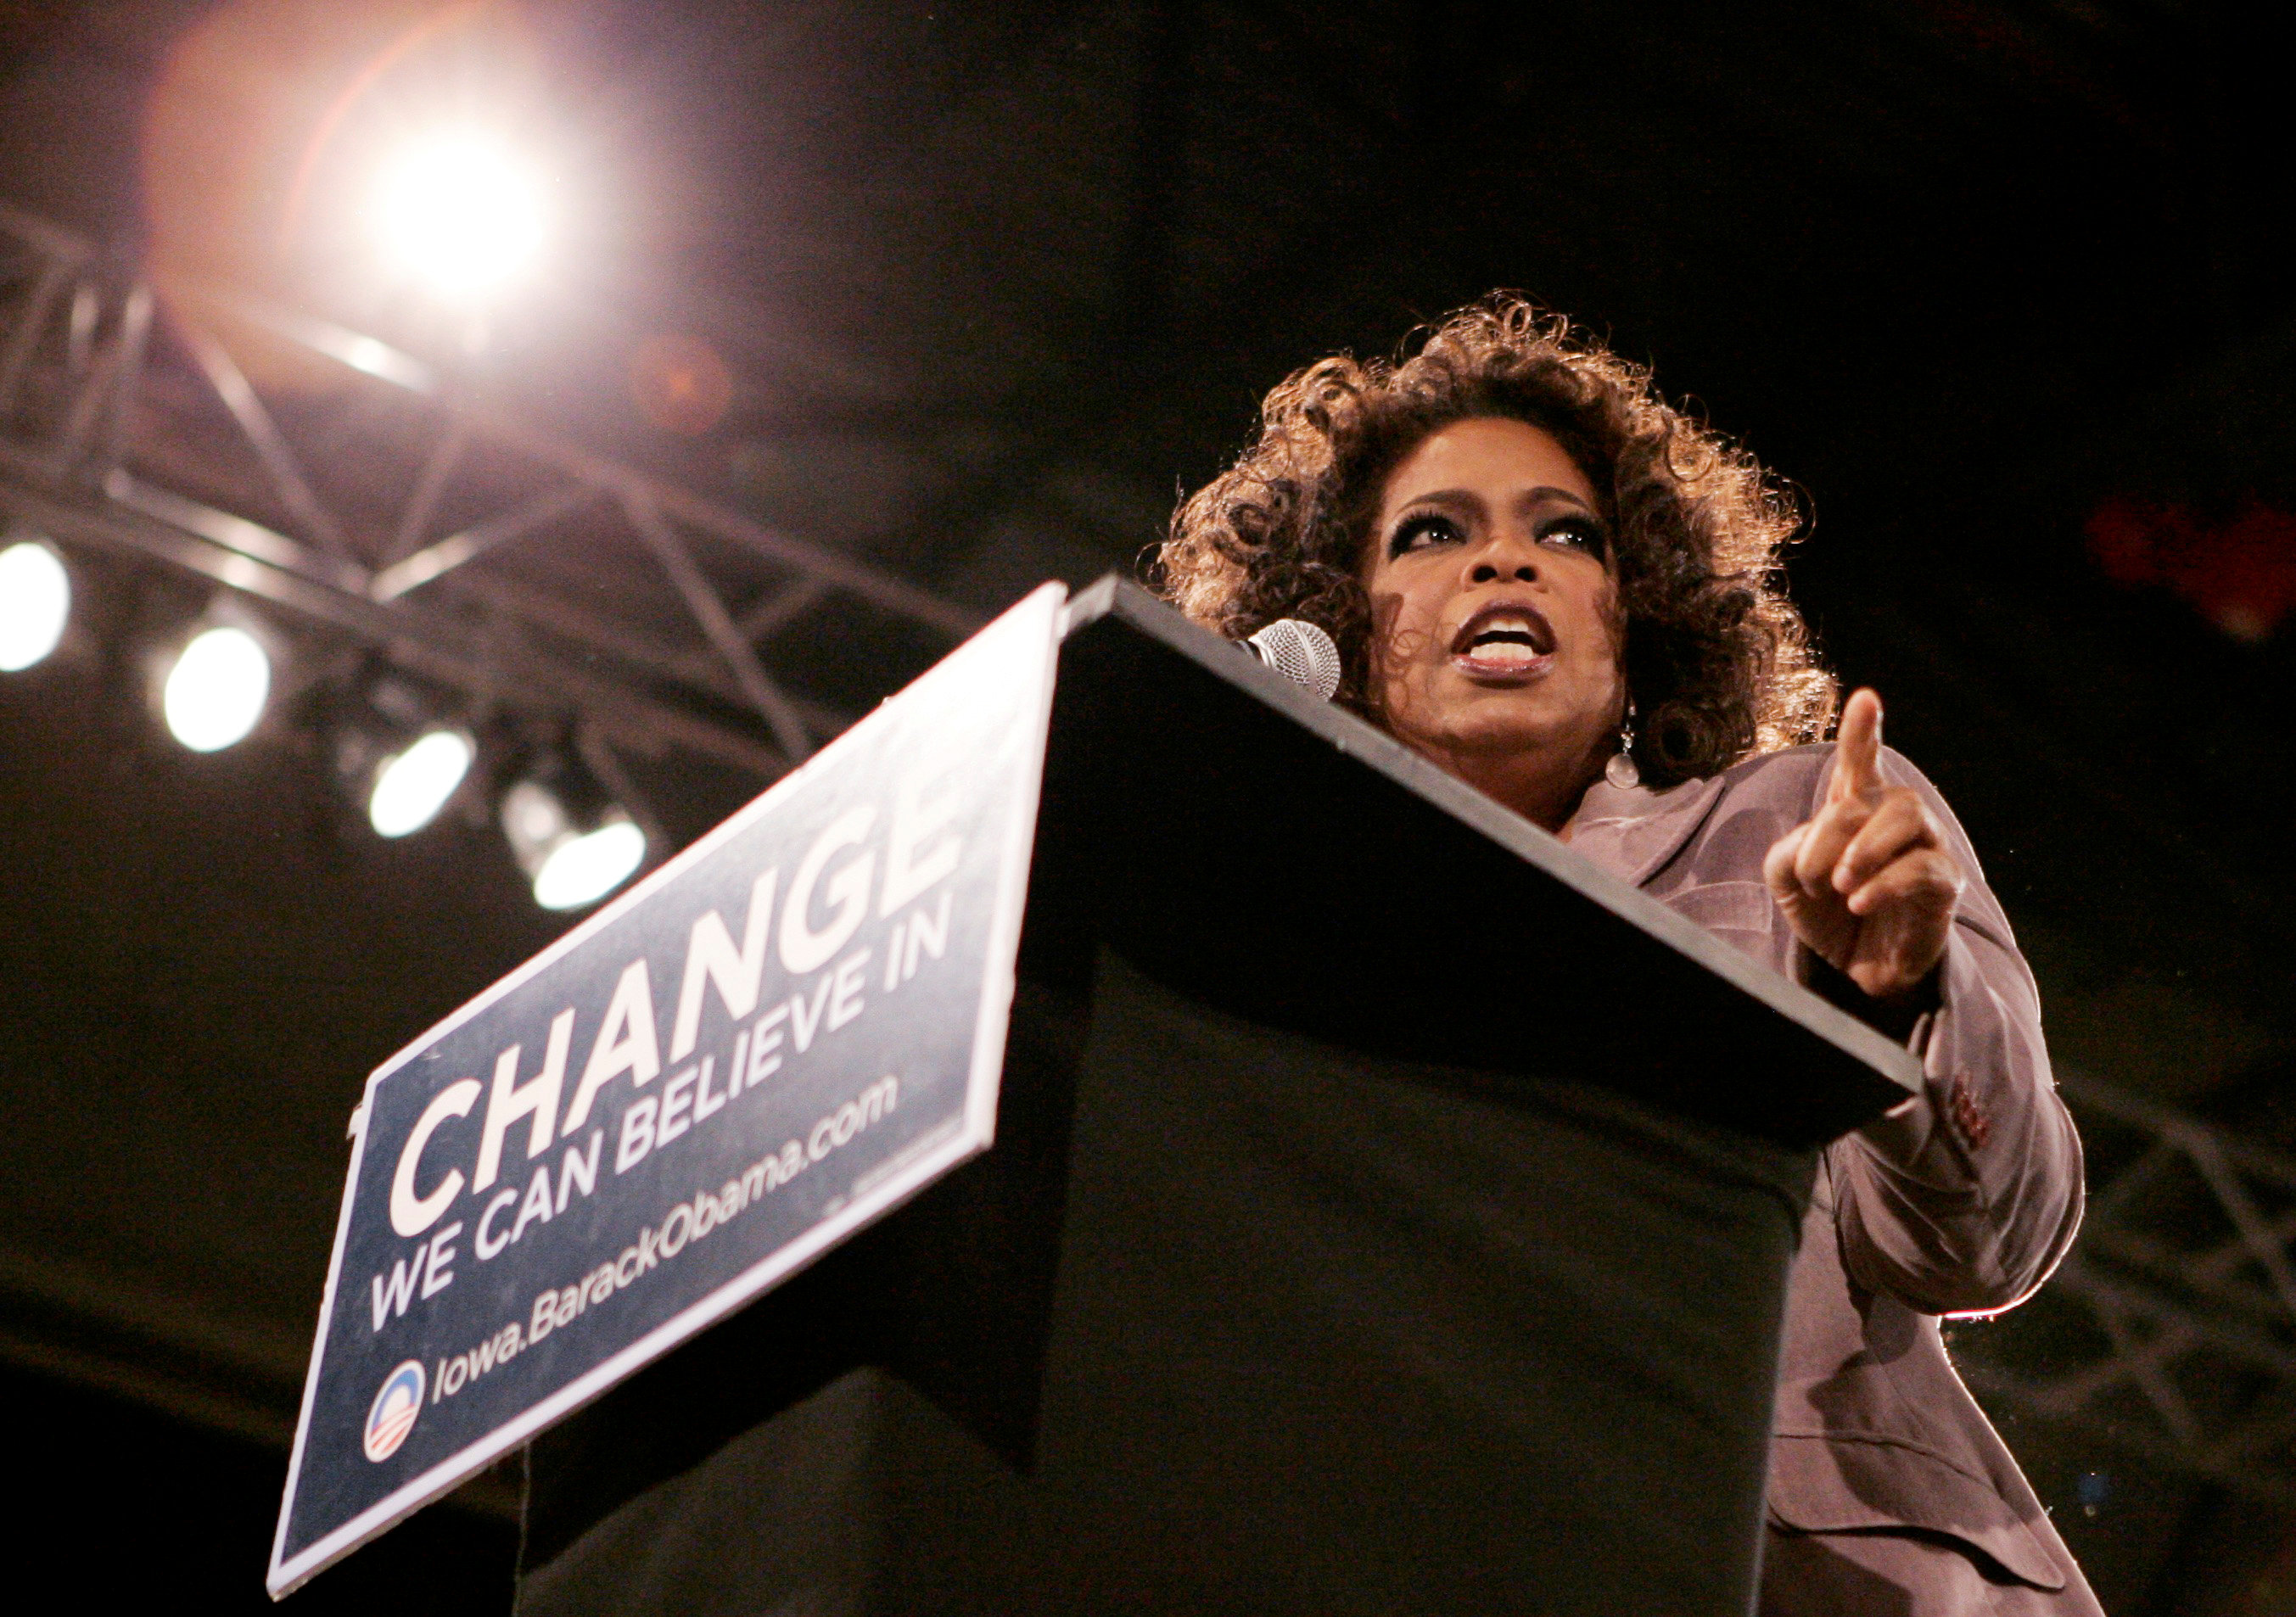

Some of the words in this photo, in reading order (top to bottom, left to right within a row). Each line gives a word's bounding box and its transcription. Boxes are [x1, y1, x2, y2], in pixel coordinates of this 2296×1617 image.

[371, 1220, 463, 1332] WE
[475, 1130, 602, 1261] CAN
[615, 946, 872, 1174] BELIEVE
[885, 891, 955, 993] IN
[388, 738, 965, 1237] CHANGE
[433, 1075, 898, 1405] Iowa.BarackObama.com
